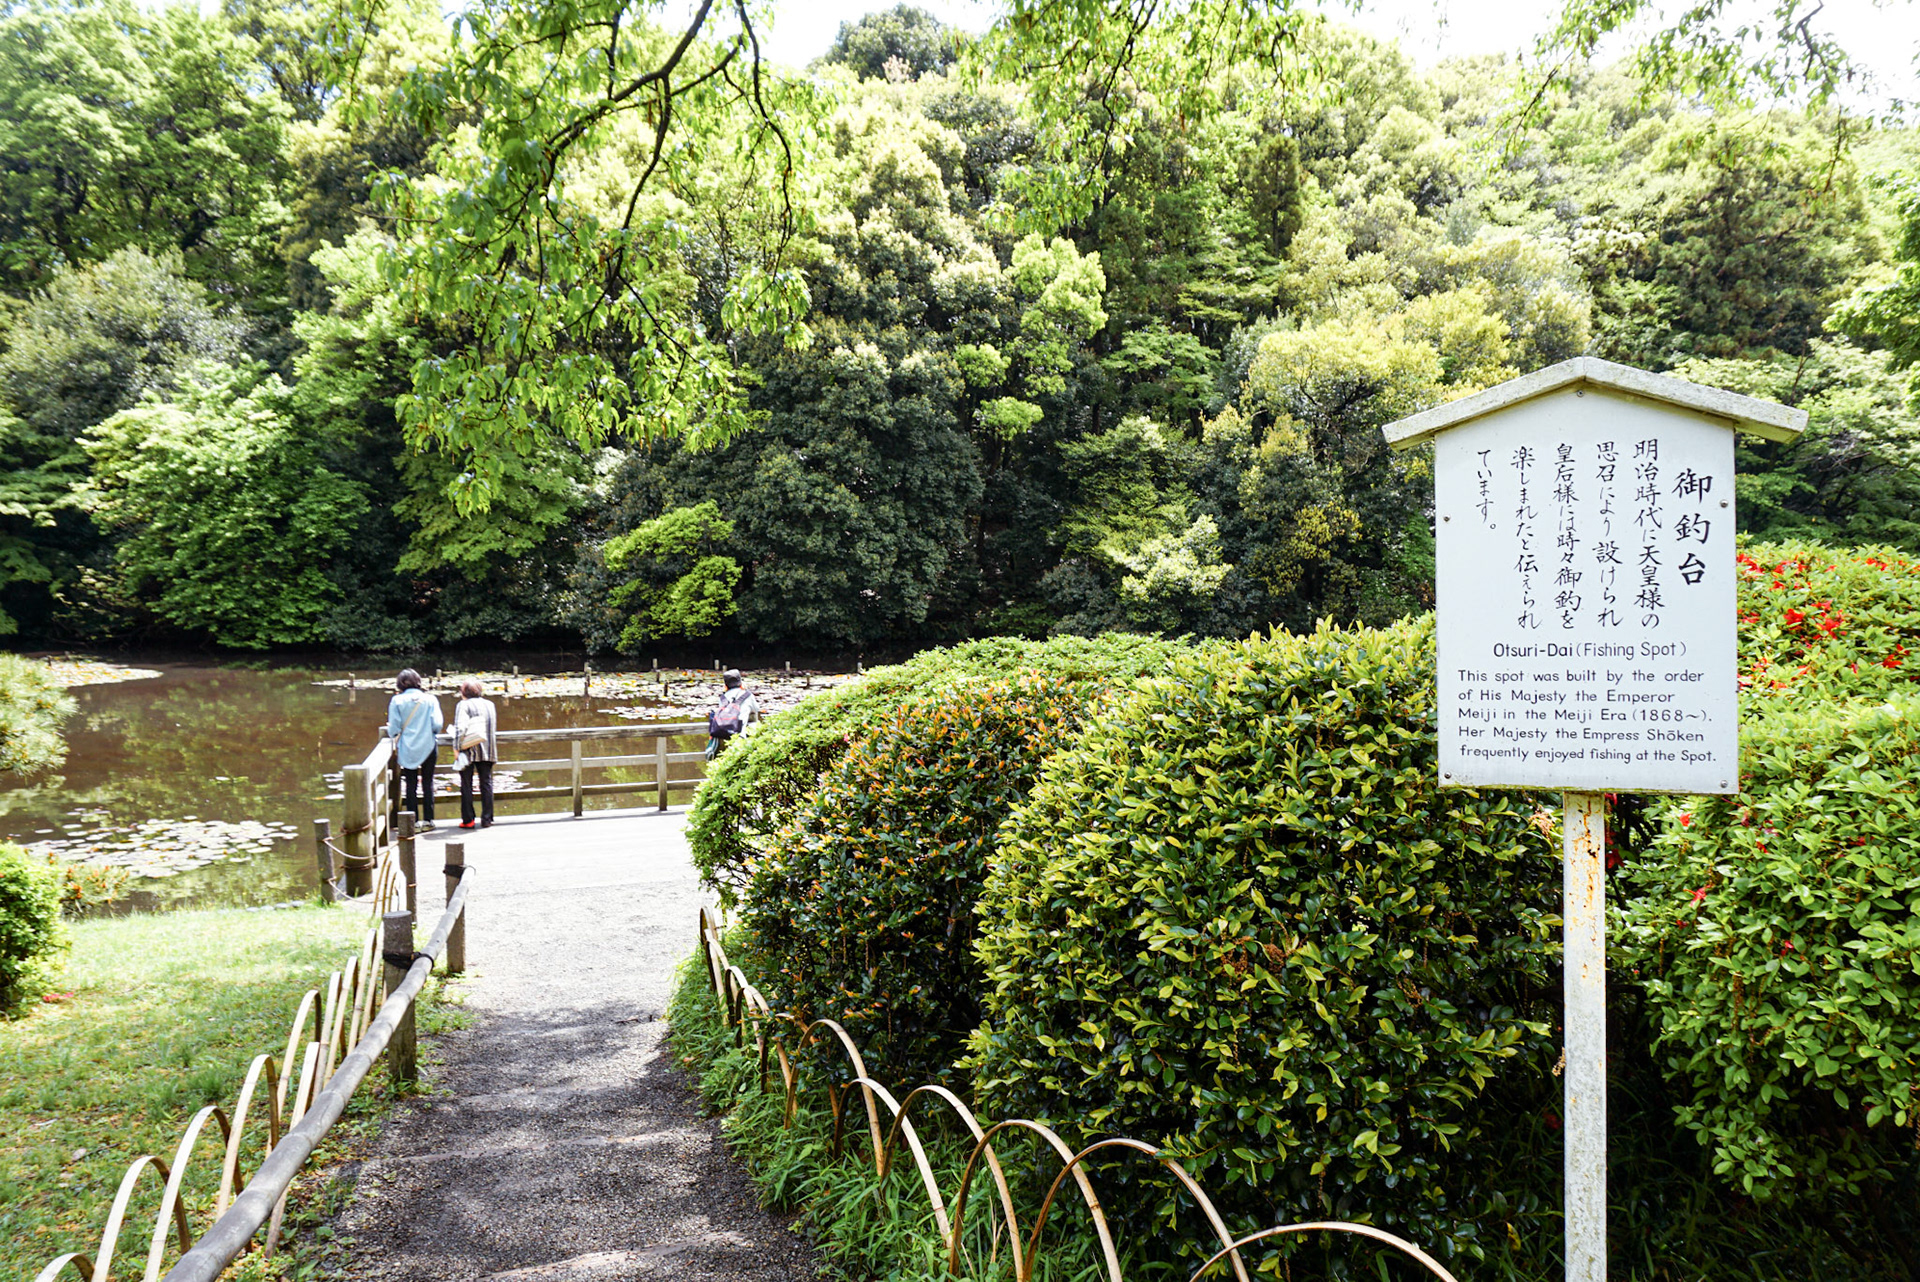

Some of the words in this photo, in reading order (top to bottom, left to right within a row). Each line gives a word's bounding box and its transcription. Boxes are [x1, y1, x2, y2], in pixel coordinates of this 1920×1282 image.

[1475, 449, 1497, 530] ています。
[1671, 467, 1714, 586] 御釣台
[1510, 445, 1541, 630] 楽しまれたと伝えられ
[1552, 442, 1583, 630] 皇后様には時々御釣を
[1591, 440, 1624, 628] 思召により設けられ
[1632, 438, 1666, 629] 明治時代に天皇様の
[1457, 669, 1488, 682] This
[1494, 670, 1525, 685] spot
[1532, 672, 1560, 682] was
[1566, 669, 1597, 682] built
[1606, 669, 1624, 686] by
[1631, 668, 1656, 682] the
[1664, 669, 1705, 683] order
[1457, 688, 1474, 701] of
[1480, 689, 1502, 701] His
[1511, 689, 1567, 705] Majesty
[1575, 689, 1598, 702] the
[1606, 688, 1676, 706] Emperor
[1458, 707, 1497, 723] Meiji
[1503, 709, 1516, 721] in
[1524, 709, 1547, 720] the
[1554, 709, 1592, 724] Meiji
[1600, 708, 1627, 721] Era
[1458, 725, 1486, 738] Her
[1493, 726, 1548, 743] Majesty
[1555, 727, 1578, 740] the
[1582, 727, 1640, 744] Empress
[1646, 728, 1704, 742] Shōken
[1459, 744, 1530, 763] frequently
[1534, 747, 1585, 763] enjoyed
[1589, 747, 1631, 765] fishing
[1635, 749, 1649, 761] at
[1653, 749, 1676, 762] the
[1680, 749, 1717, 766] Spot.
